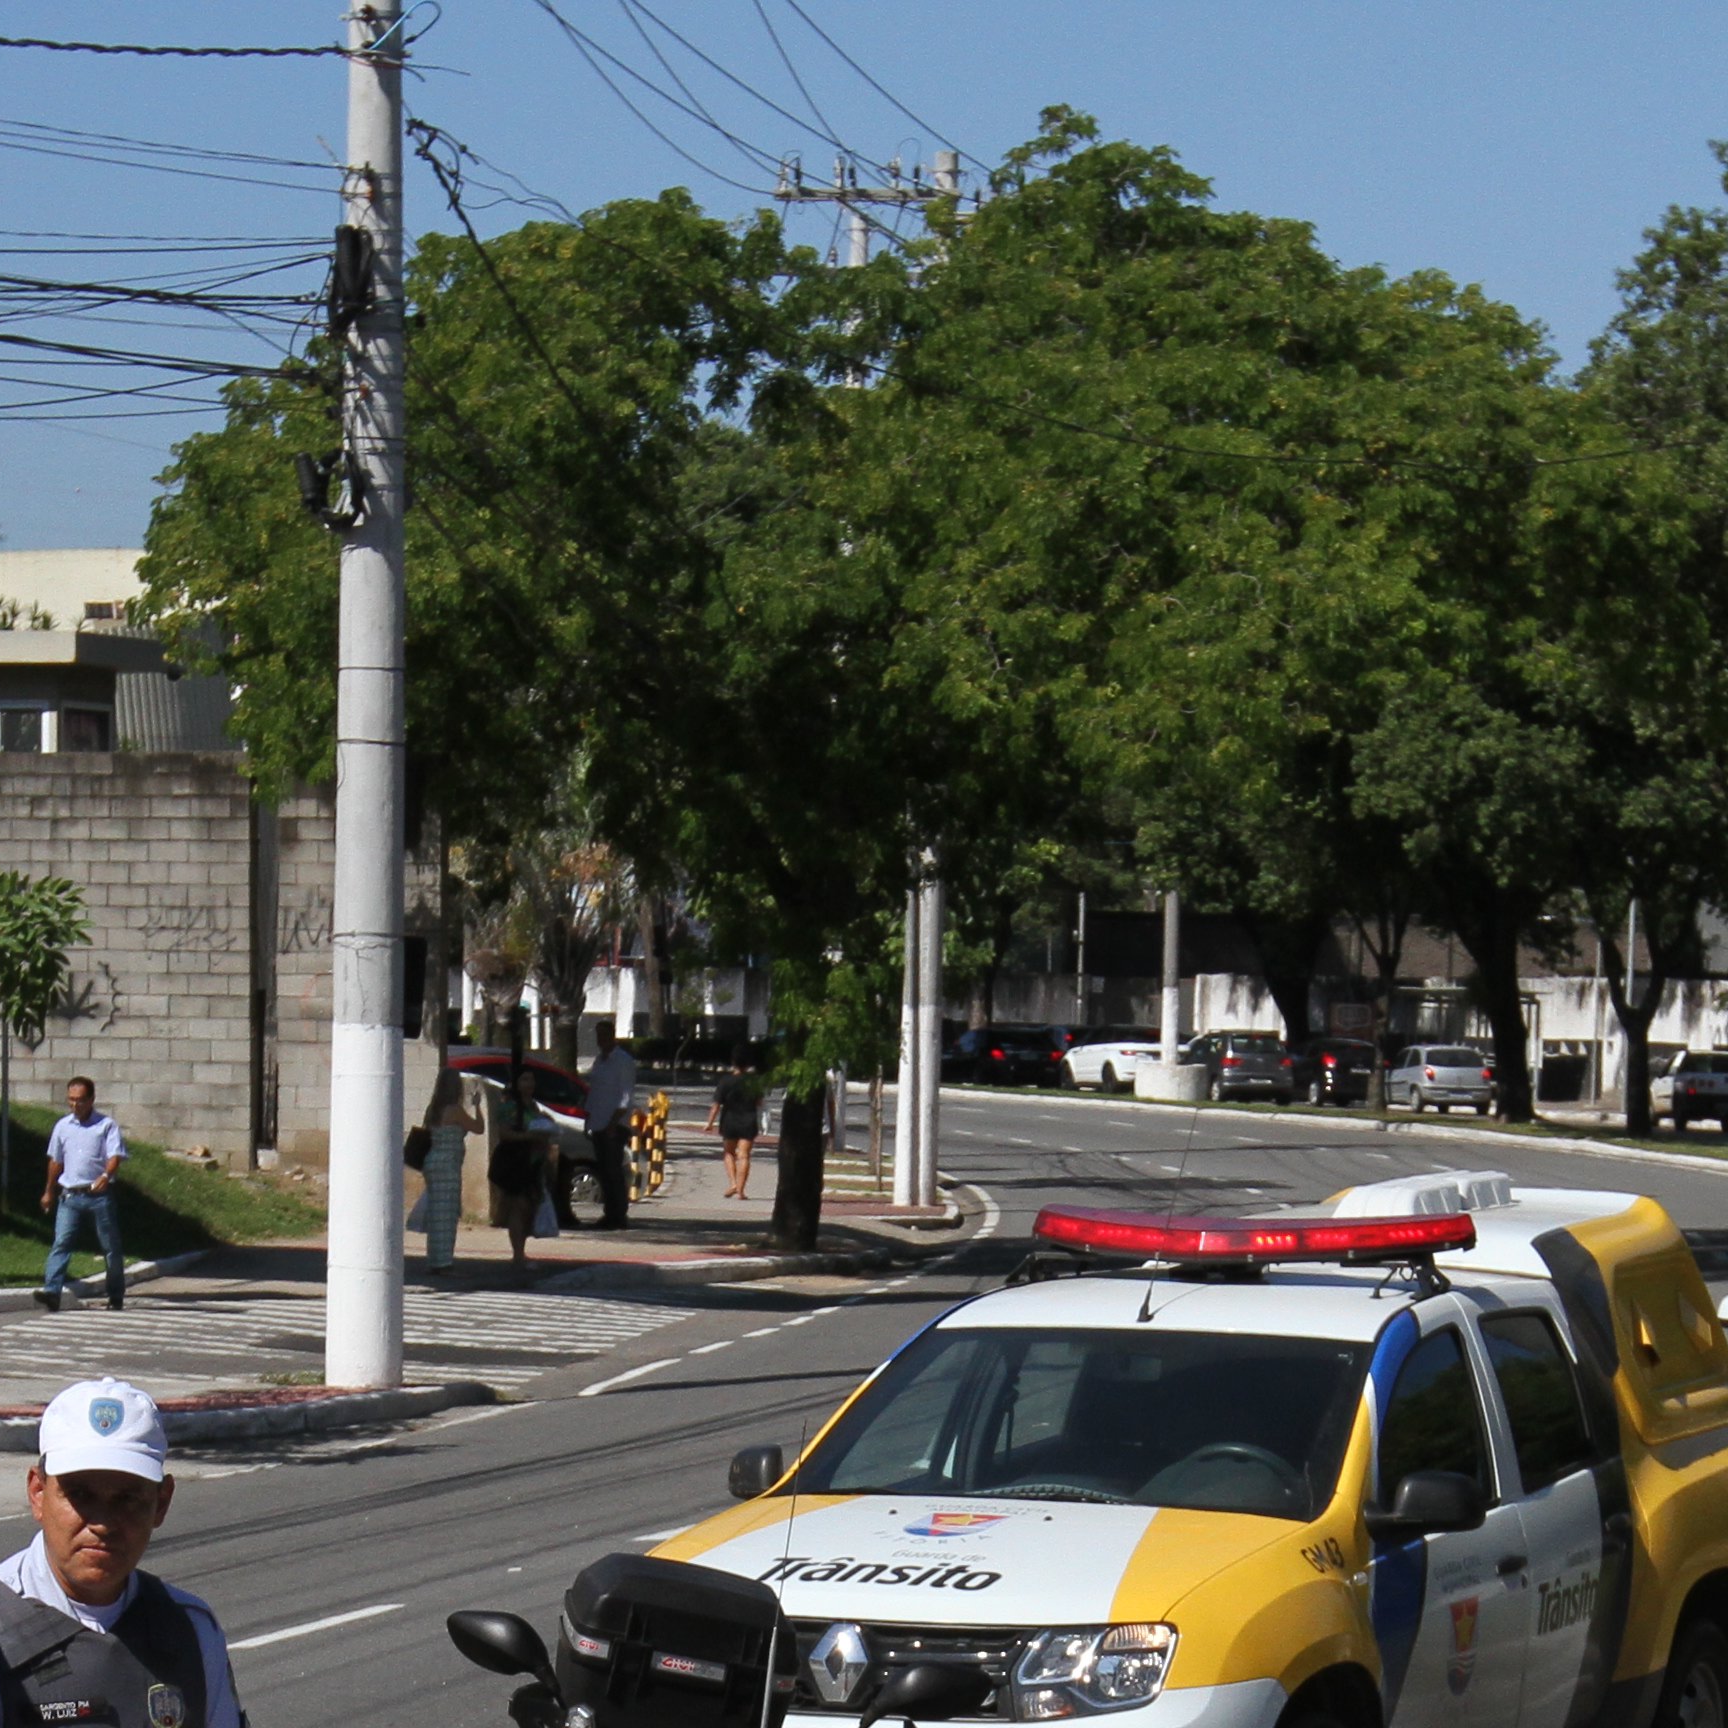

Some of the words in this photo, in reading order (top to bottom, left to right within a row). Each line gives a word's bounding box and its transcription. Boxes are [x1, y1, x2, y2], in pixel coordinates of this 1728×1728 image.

[891, 1549, 958, 1561] Guarda
[961, 1552, 987, 1562] de
[756, 1556, 1003, 1592] Trânsito
[39, 1701, 76, 1711] SARGENTO
[78, 1700, 90, 1708] PM
[42, 1711, 55, 1721] W.
[57, 1708, 77, 1719] LUIZ
